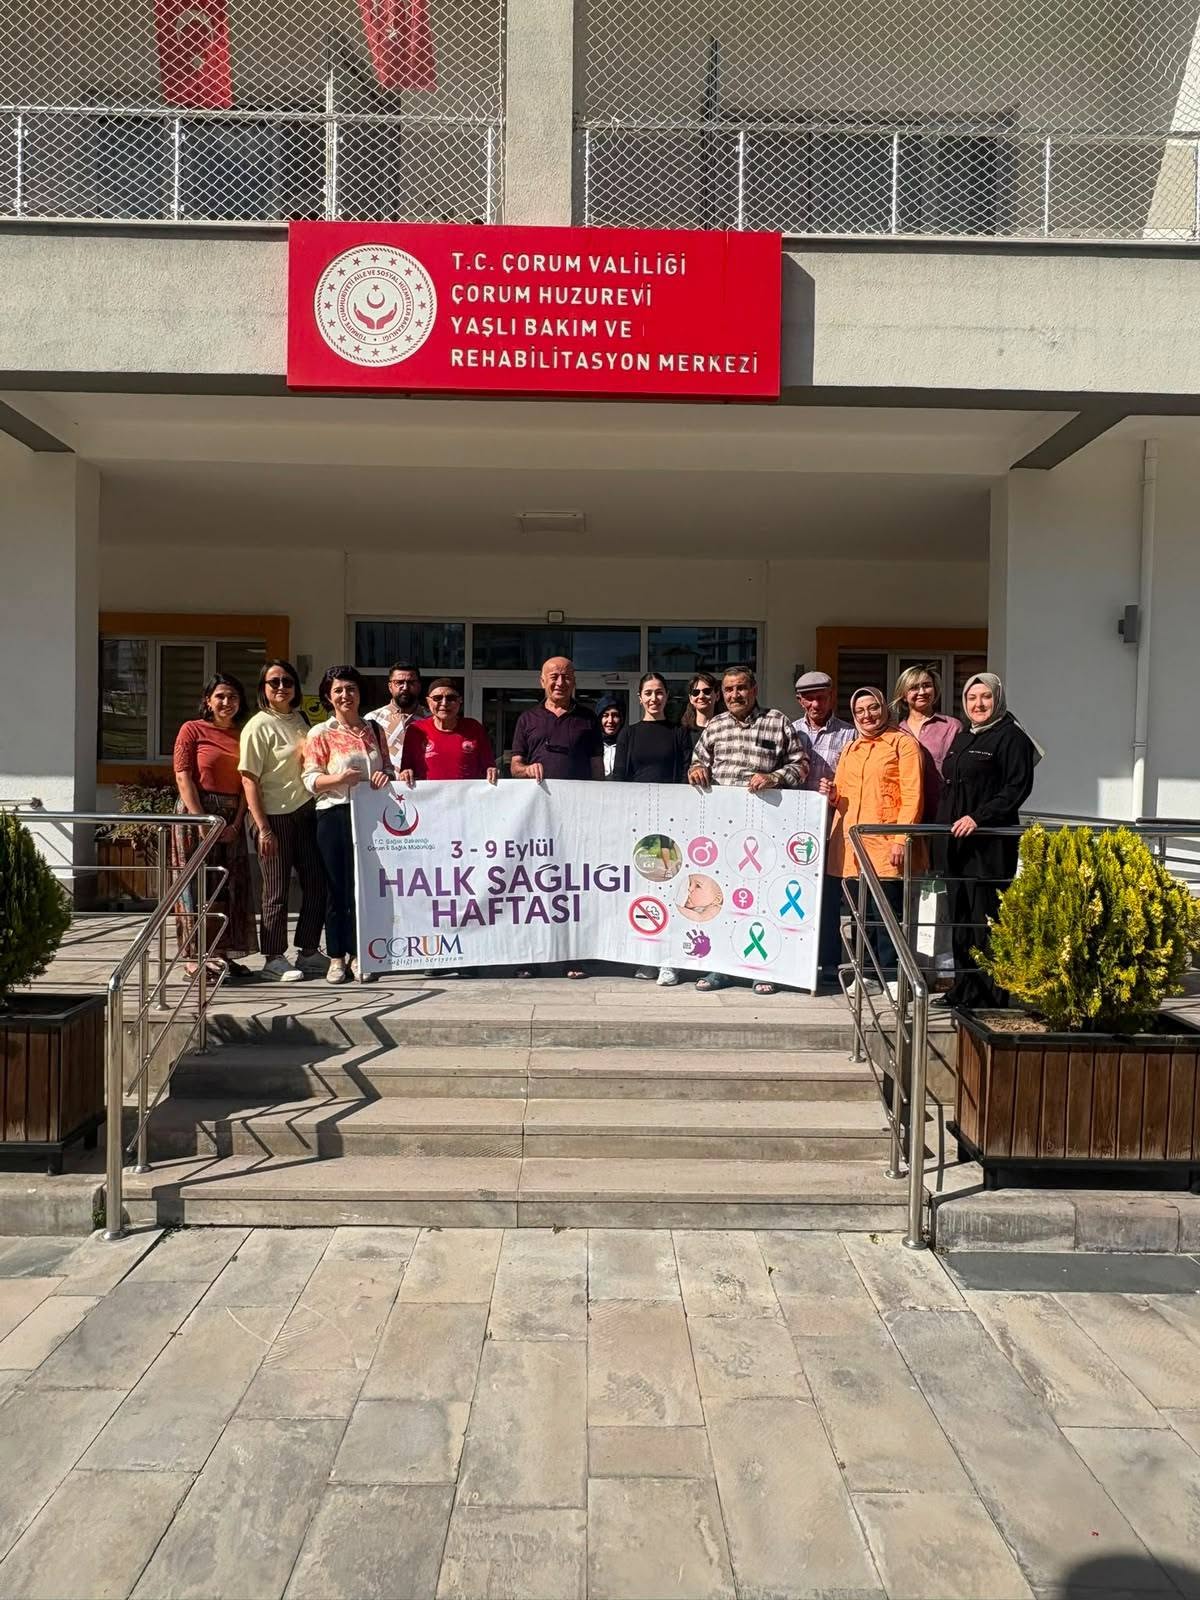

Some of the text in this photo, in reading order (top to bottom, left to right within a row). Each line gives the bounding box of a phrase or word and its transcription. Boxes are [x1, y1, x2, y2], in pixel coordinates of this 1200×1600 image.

[452, 252, 686, 275] T.C. ÇORUM VALİLİĞİ
[451, 284, 651, 306] ÇORUM HUZUREVİ
[450, 316, 632, 338] YAŞLI BAKIM VE
[451, 346, 757, 374] REHABİLİTASYON MERKEZİ
[451, 840, 463, 859] 3
[485, 839, 497, 859] 9
[505, 838, 554, 862] Eylül
[379, 863, 631, 898] HALK SAĞLIĞI
[432, 894, 580, 928] HAFTASI
[368, 933, 464, 964] ÇORUM
